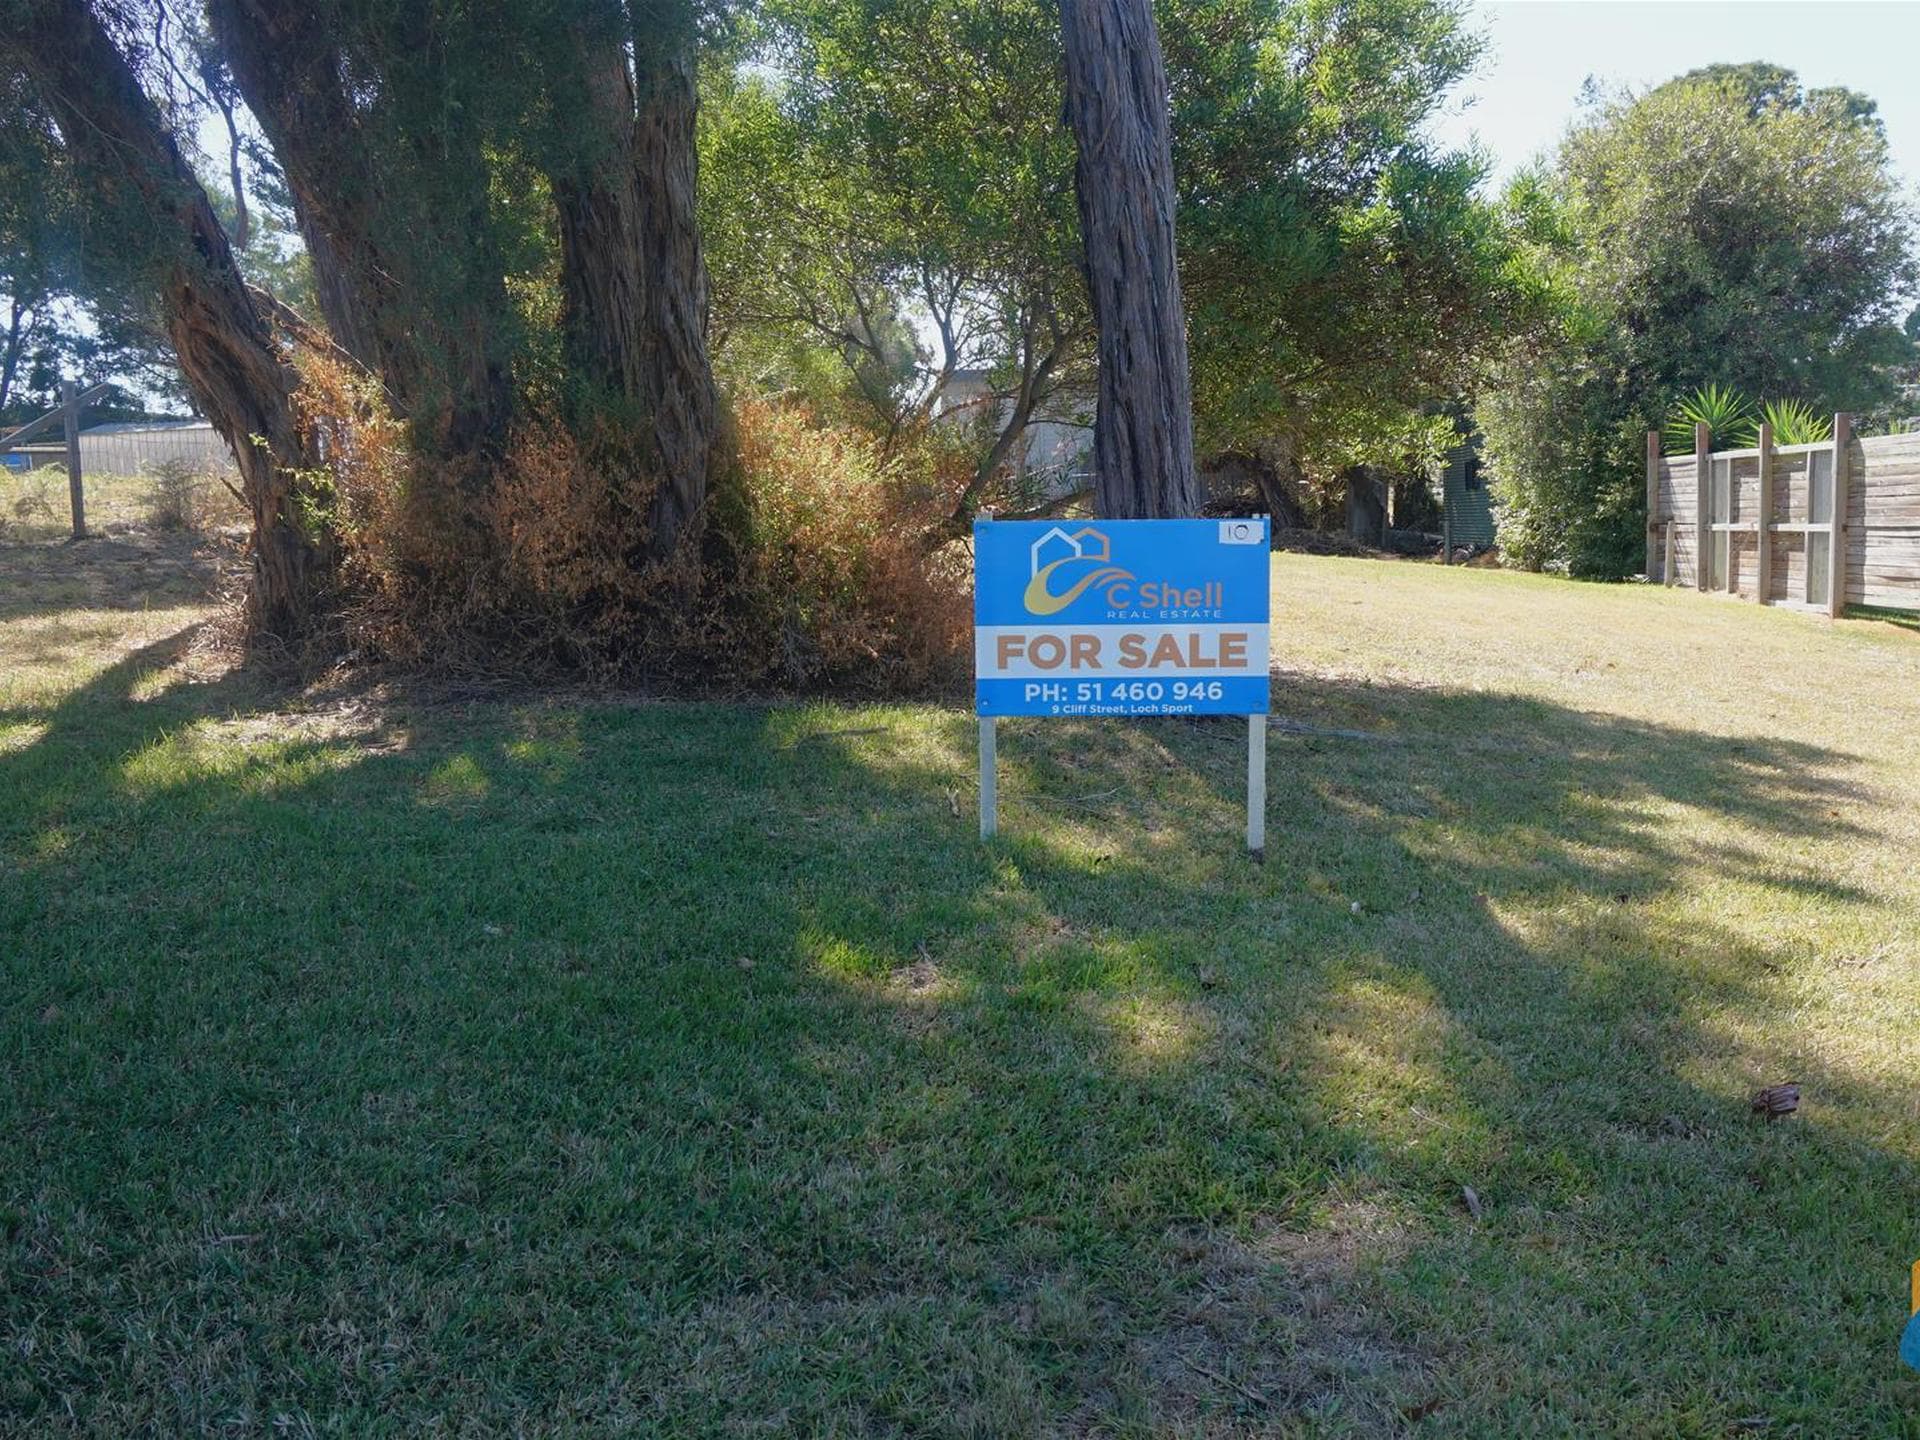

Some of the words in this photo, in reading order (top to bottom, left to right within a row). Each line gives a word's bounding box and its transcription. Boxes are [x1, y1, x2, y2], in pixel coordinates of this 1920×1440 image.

[1106, 583, 1131, 609] C
[1138, 581, 1223, 609] Shell
[1106, 610, 1151, 619] REAL
[1159, 609, 1222, 619] ESTATE
[996, 634, 1103, 670] FOR
[1117, 632, 1249, 669] SALE
[1025, 683, 1069, 702] PH:
[1076, 683, 1102, 702] 51
[1110, 682, 1164, 701] 460
[1172, 681, 1223, 701] 946
[1051, 704, 1060, 714] 9
[1062, 703, 1088, 714] Cliff
[1089, 703, 1128, 715] Street,
[1130, 703, 1159, 714] Loch
[1161, 703, 1193, 715] Sport
